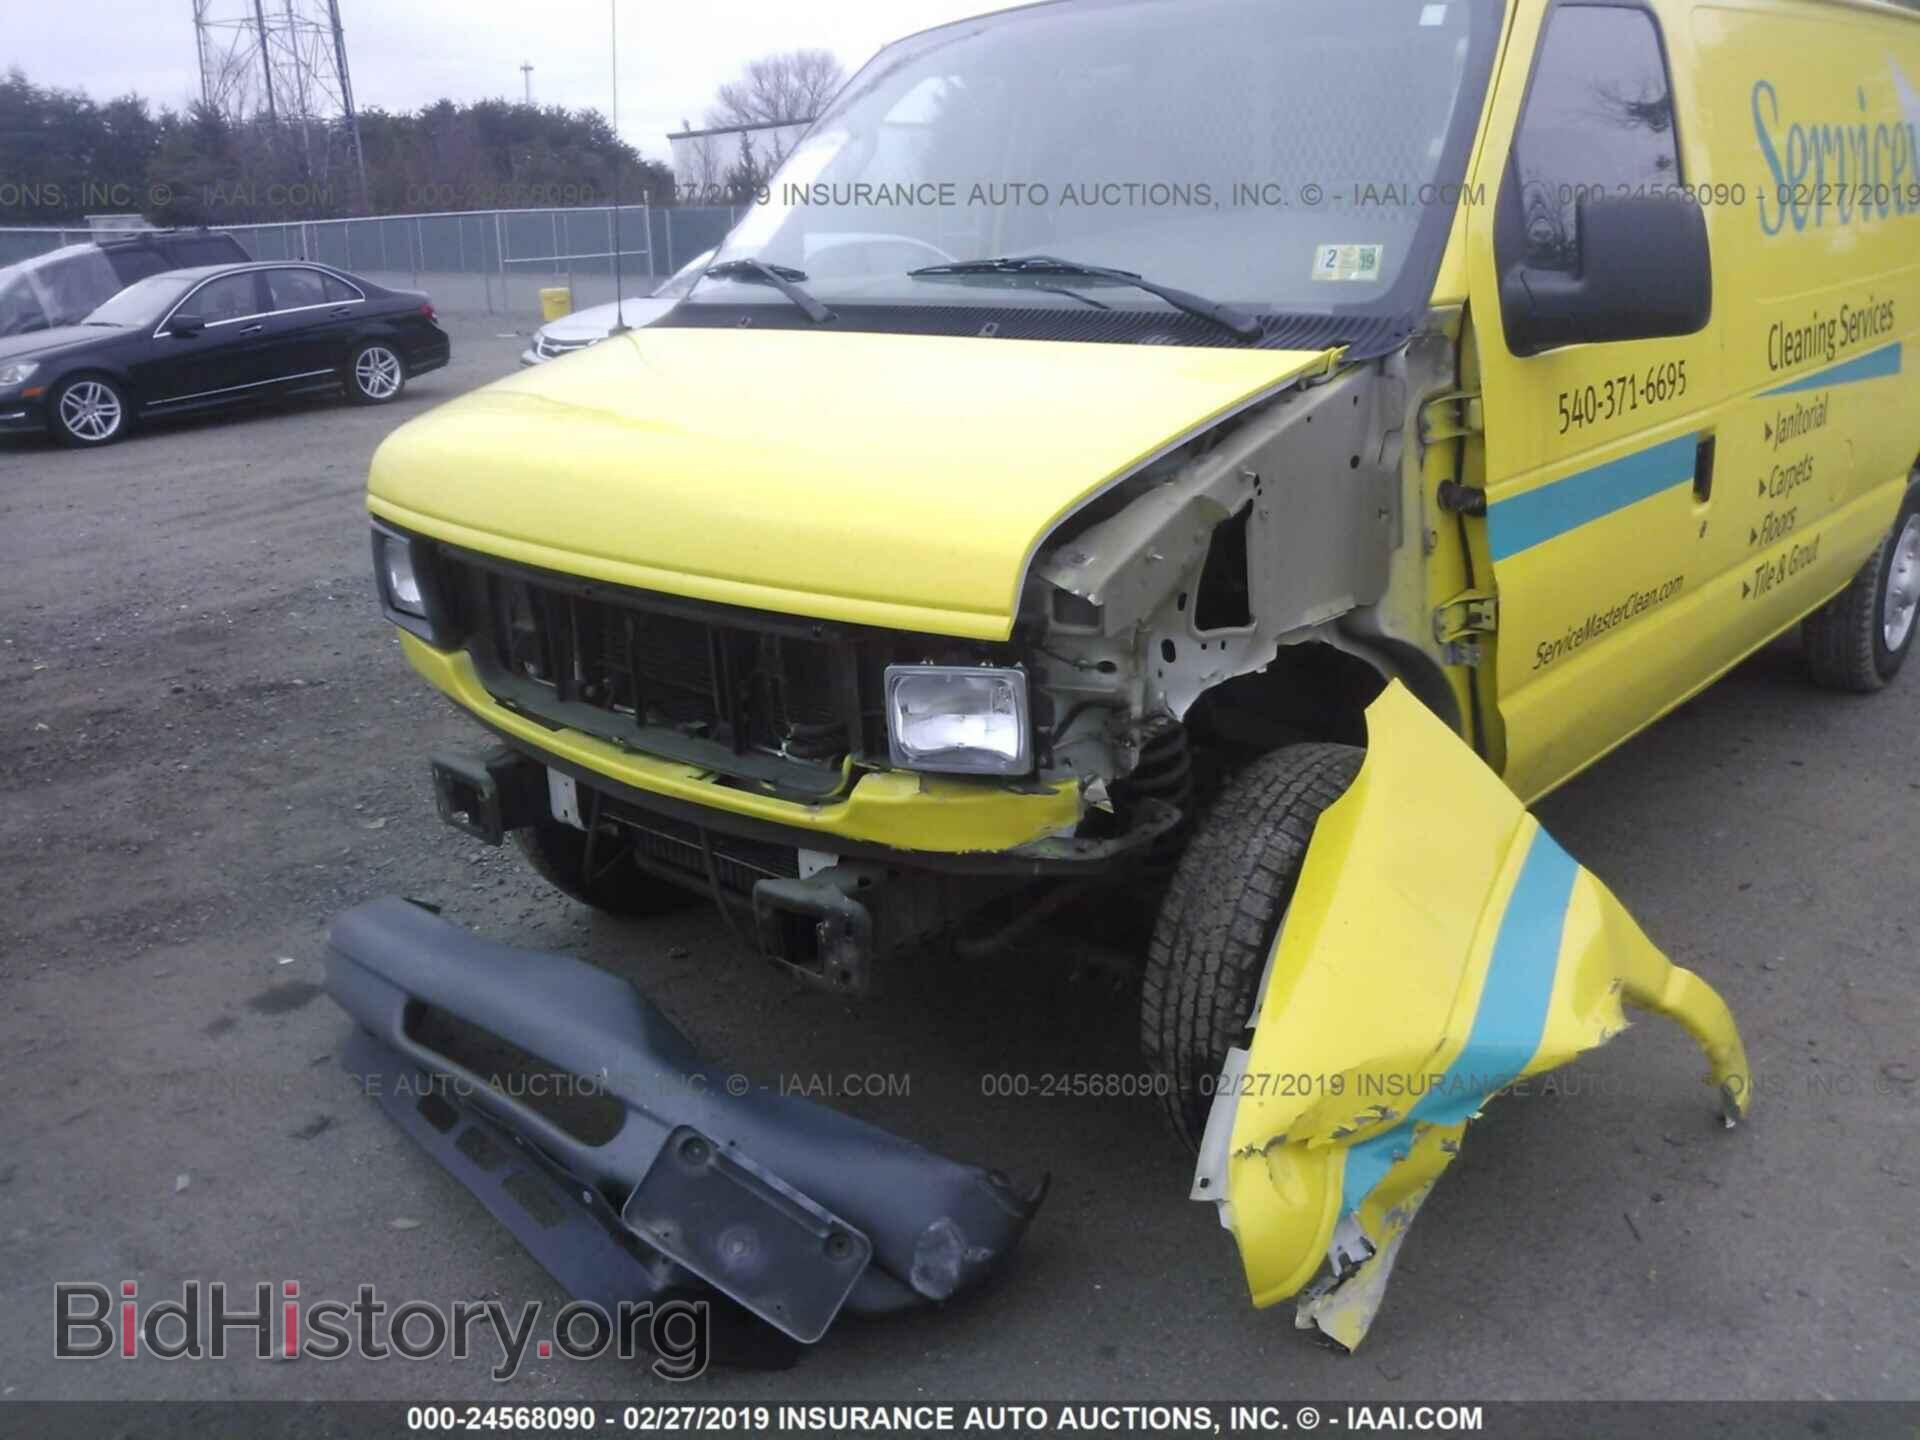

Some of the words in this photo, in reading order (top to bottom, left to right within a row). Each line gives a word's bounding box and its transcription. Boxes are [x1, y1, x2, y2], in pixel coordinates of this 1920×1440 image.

[1325, 248, 1338, 269] 2
[1767, 310, 1837, 372] Cleaning
[1840, 295, 1894, 346] Services
[1558, 360, 1688, 435] 540-371-6695
[1773, 392, 1829, 451] Janitorial
[1768, 454, 1815, 500] Carpets
[1533, 574, 1685, 671] ServiceMasterClean.com
